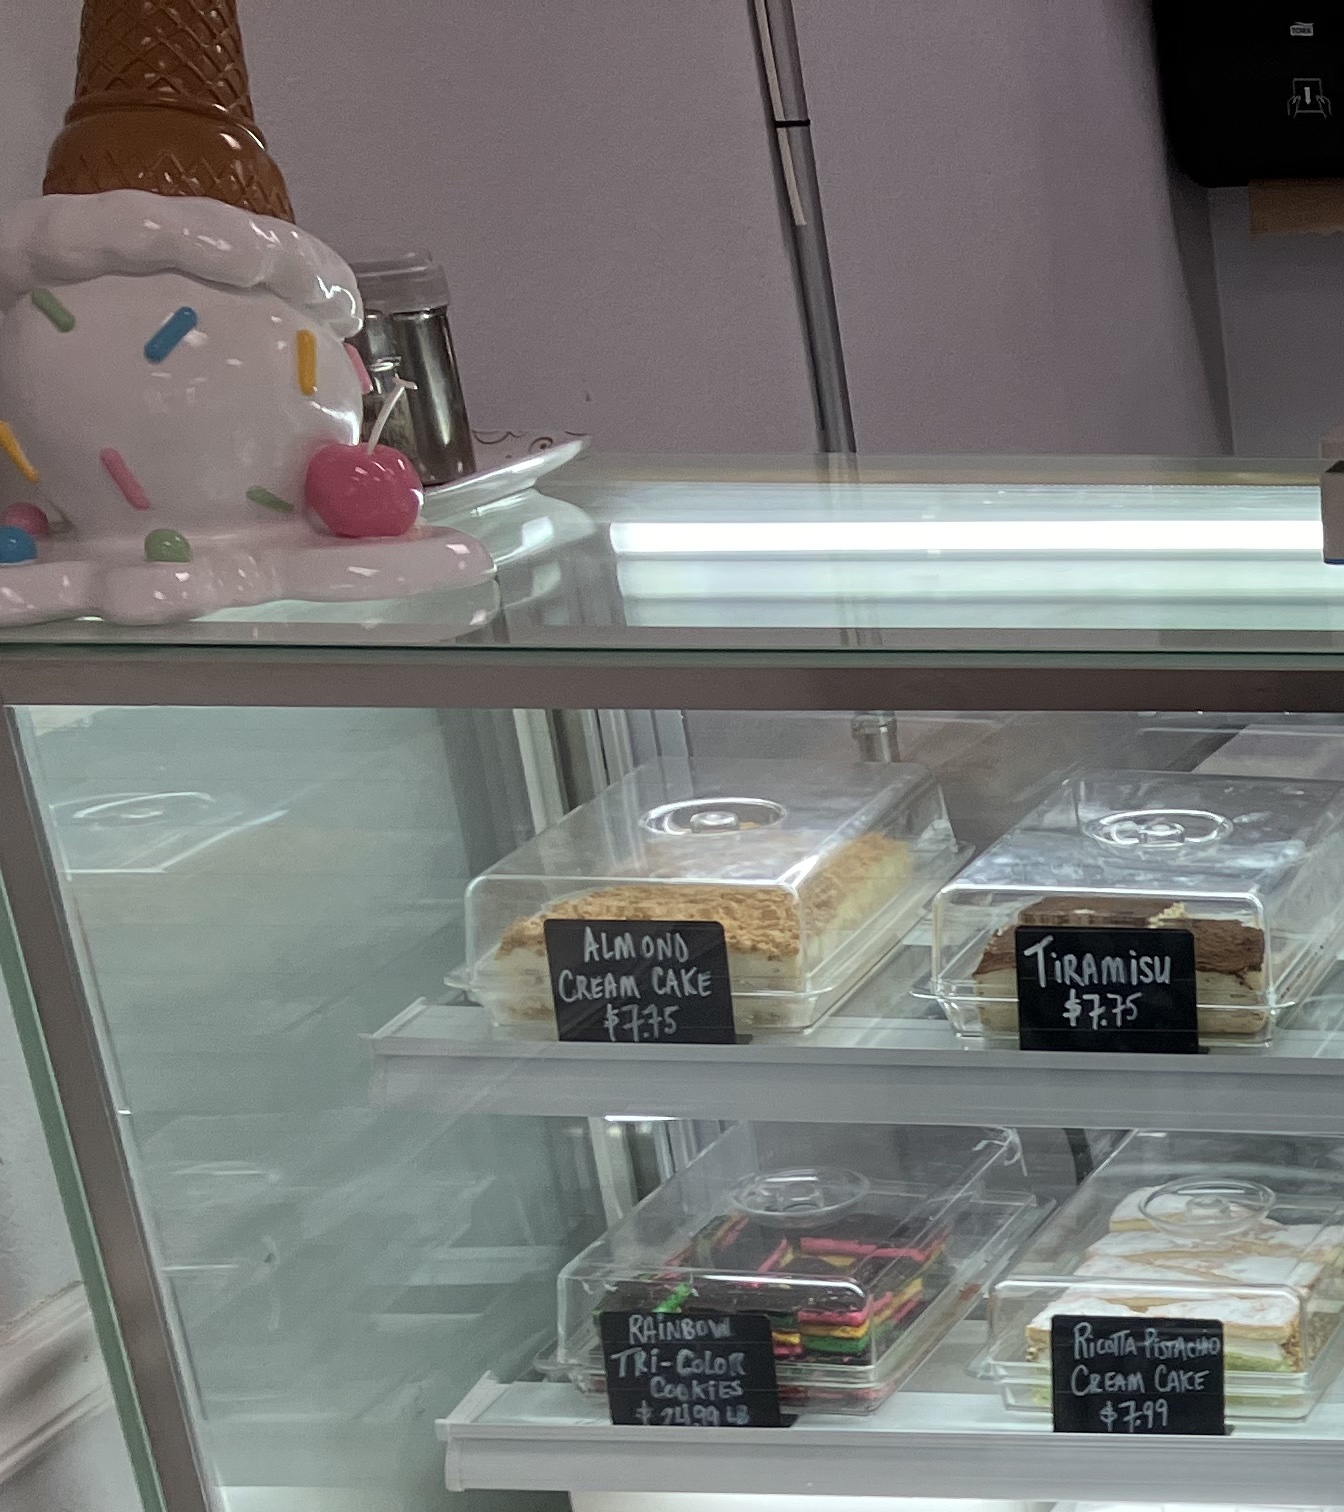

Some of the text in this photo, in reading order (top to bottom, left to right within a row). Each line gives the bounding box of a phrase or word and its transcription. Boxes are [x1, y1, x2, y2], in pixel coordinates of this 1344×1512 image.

[583, 927, 690, 964] ALMOND
[557, 968, 713, 1001] CREAM CAKE
[603, 1004, 680, 1043] $7.75
[1062, 988, 1141, 1031] $7.75
[1071, 1365, 1213, 1397] CREAM CAKE
[1099, 1399, 1168, 1431] $7.99
